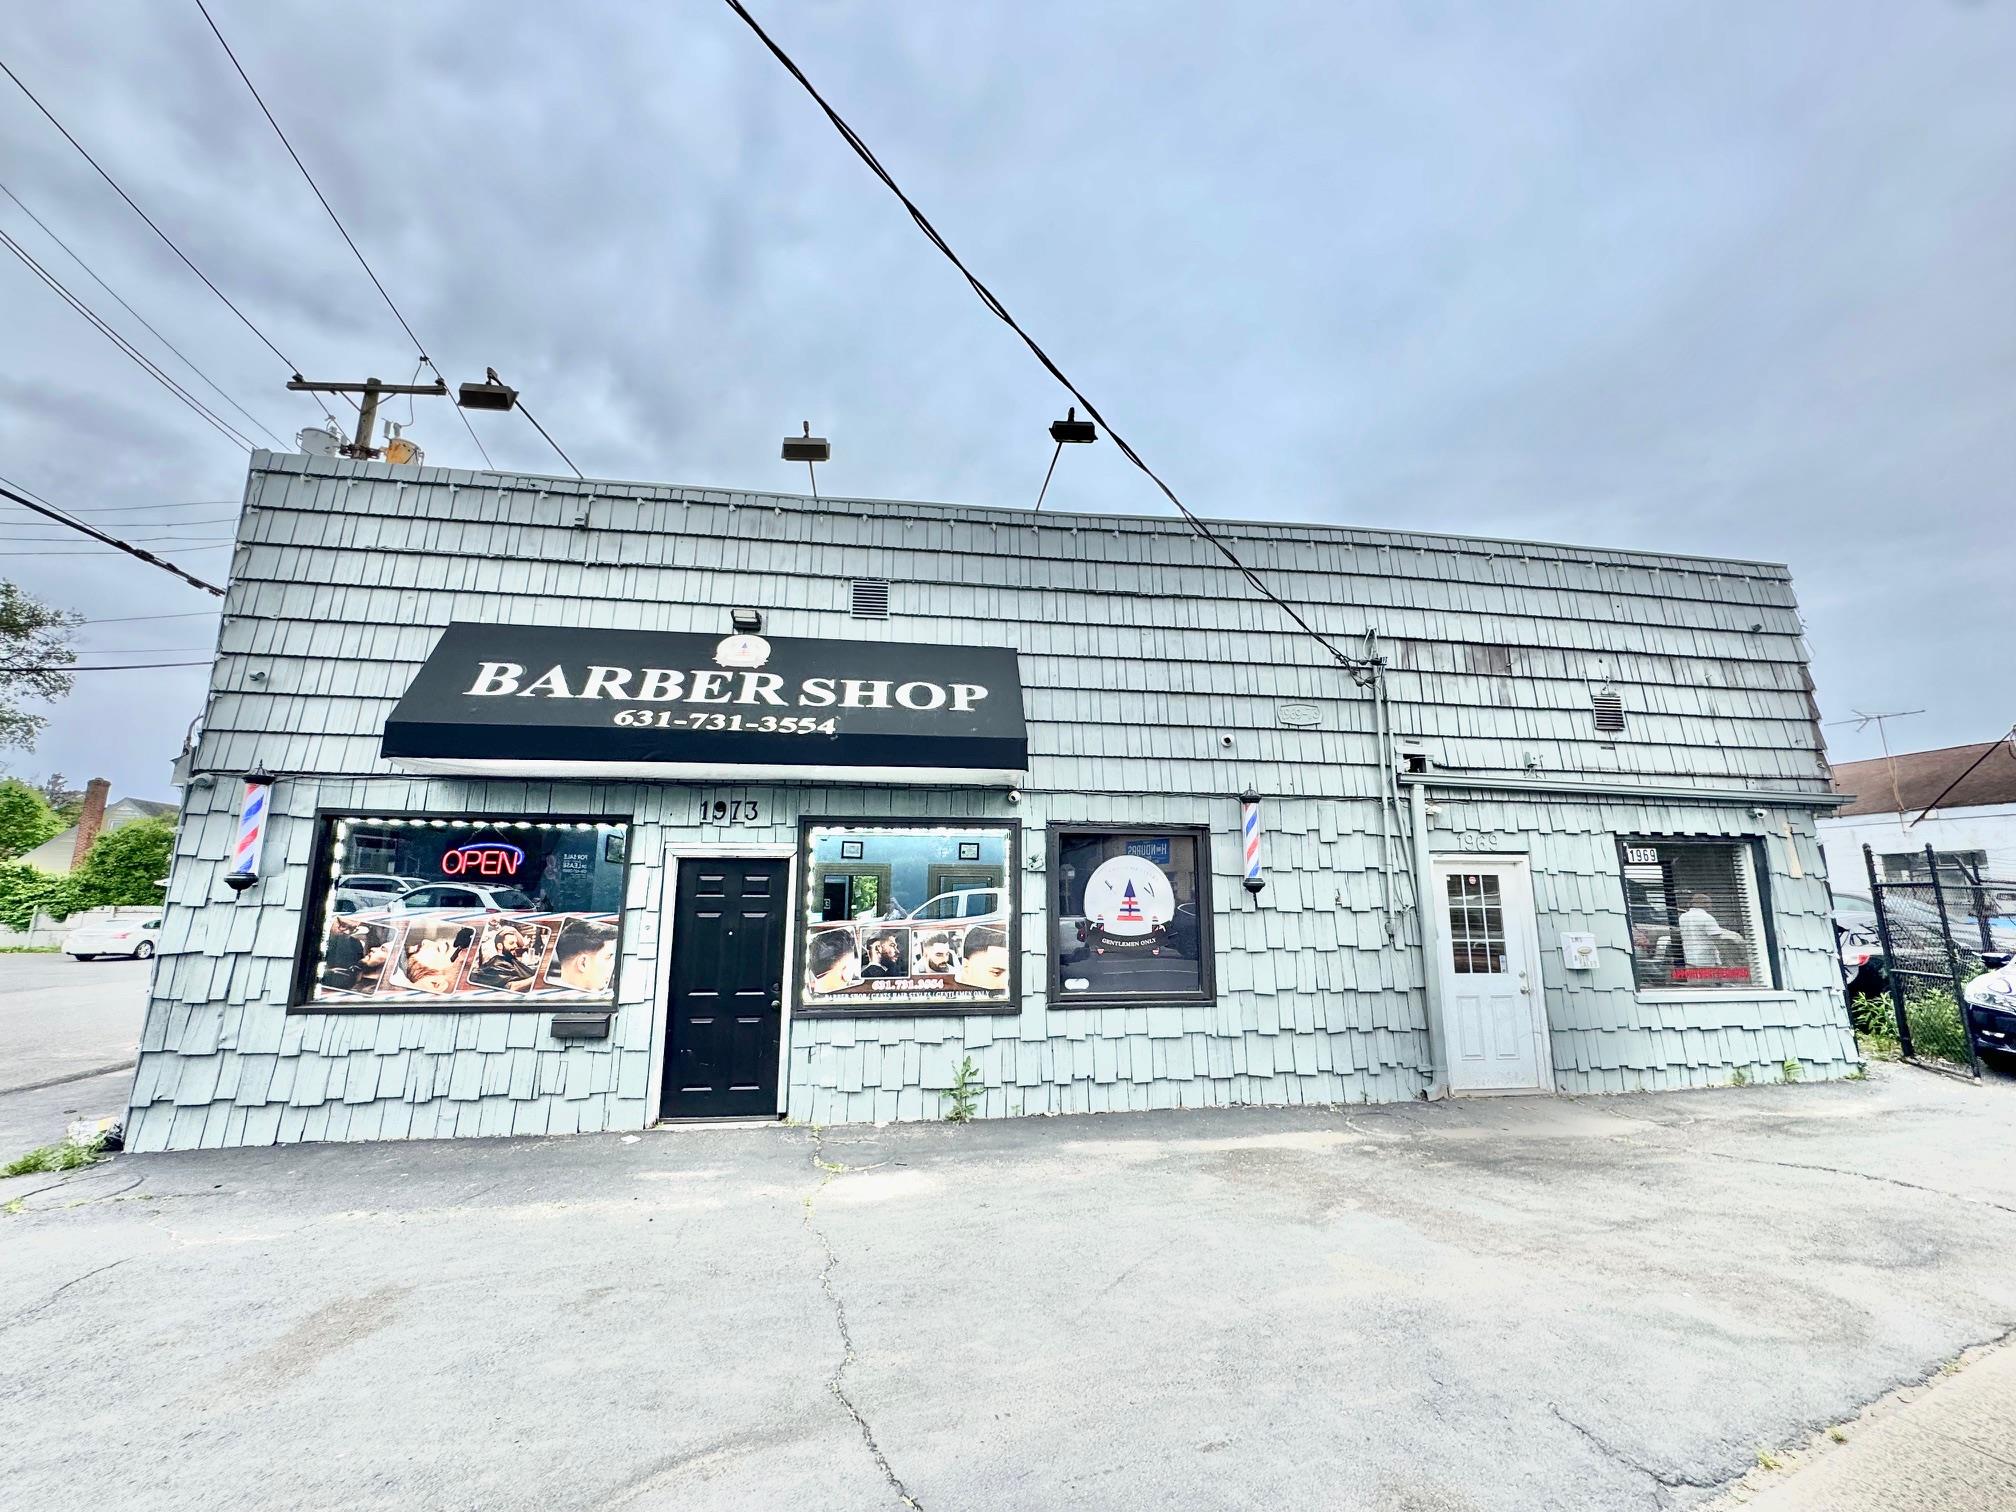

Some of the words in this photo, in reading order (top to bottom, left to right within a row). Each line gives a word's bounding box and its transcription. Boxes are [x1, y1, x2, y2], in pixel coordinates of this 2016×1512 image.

[462, 661, 790, 706] BARBER
[799, 677, 989, 712] SHOP
[613, 708, 836, 735] 631-731-3554
[701, 800, 758, 821] 1973
[1456, 833, 1498, 851] 1969
[442, 849, 519, 876] OPEN
[1629, 848, 1657, 862] 1969
[1101, 938, 1140, 947] GENTLEMEN
[1140, 937, 1157, 946] ONLY
